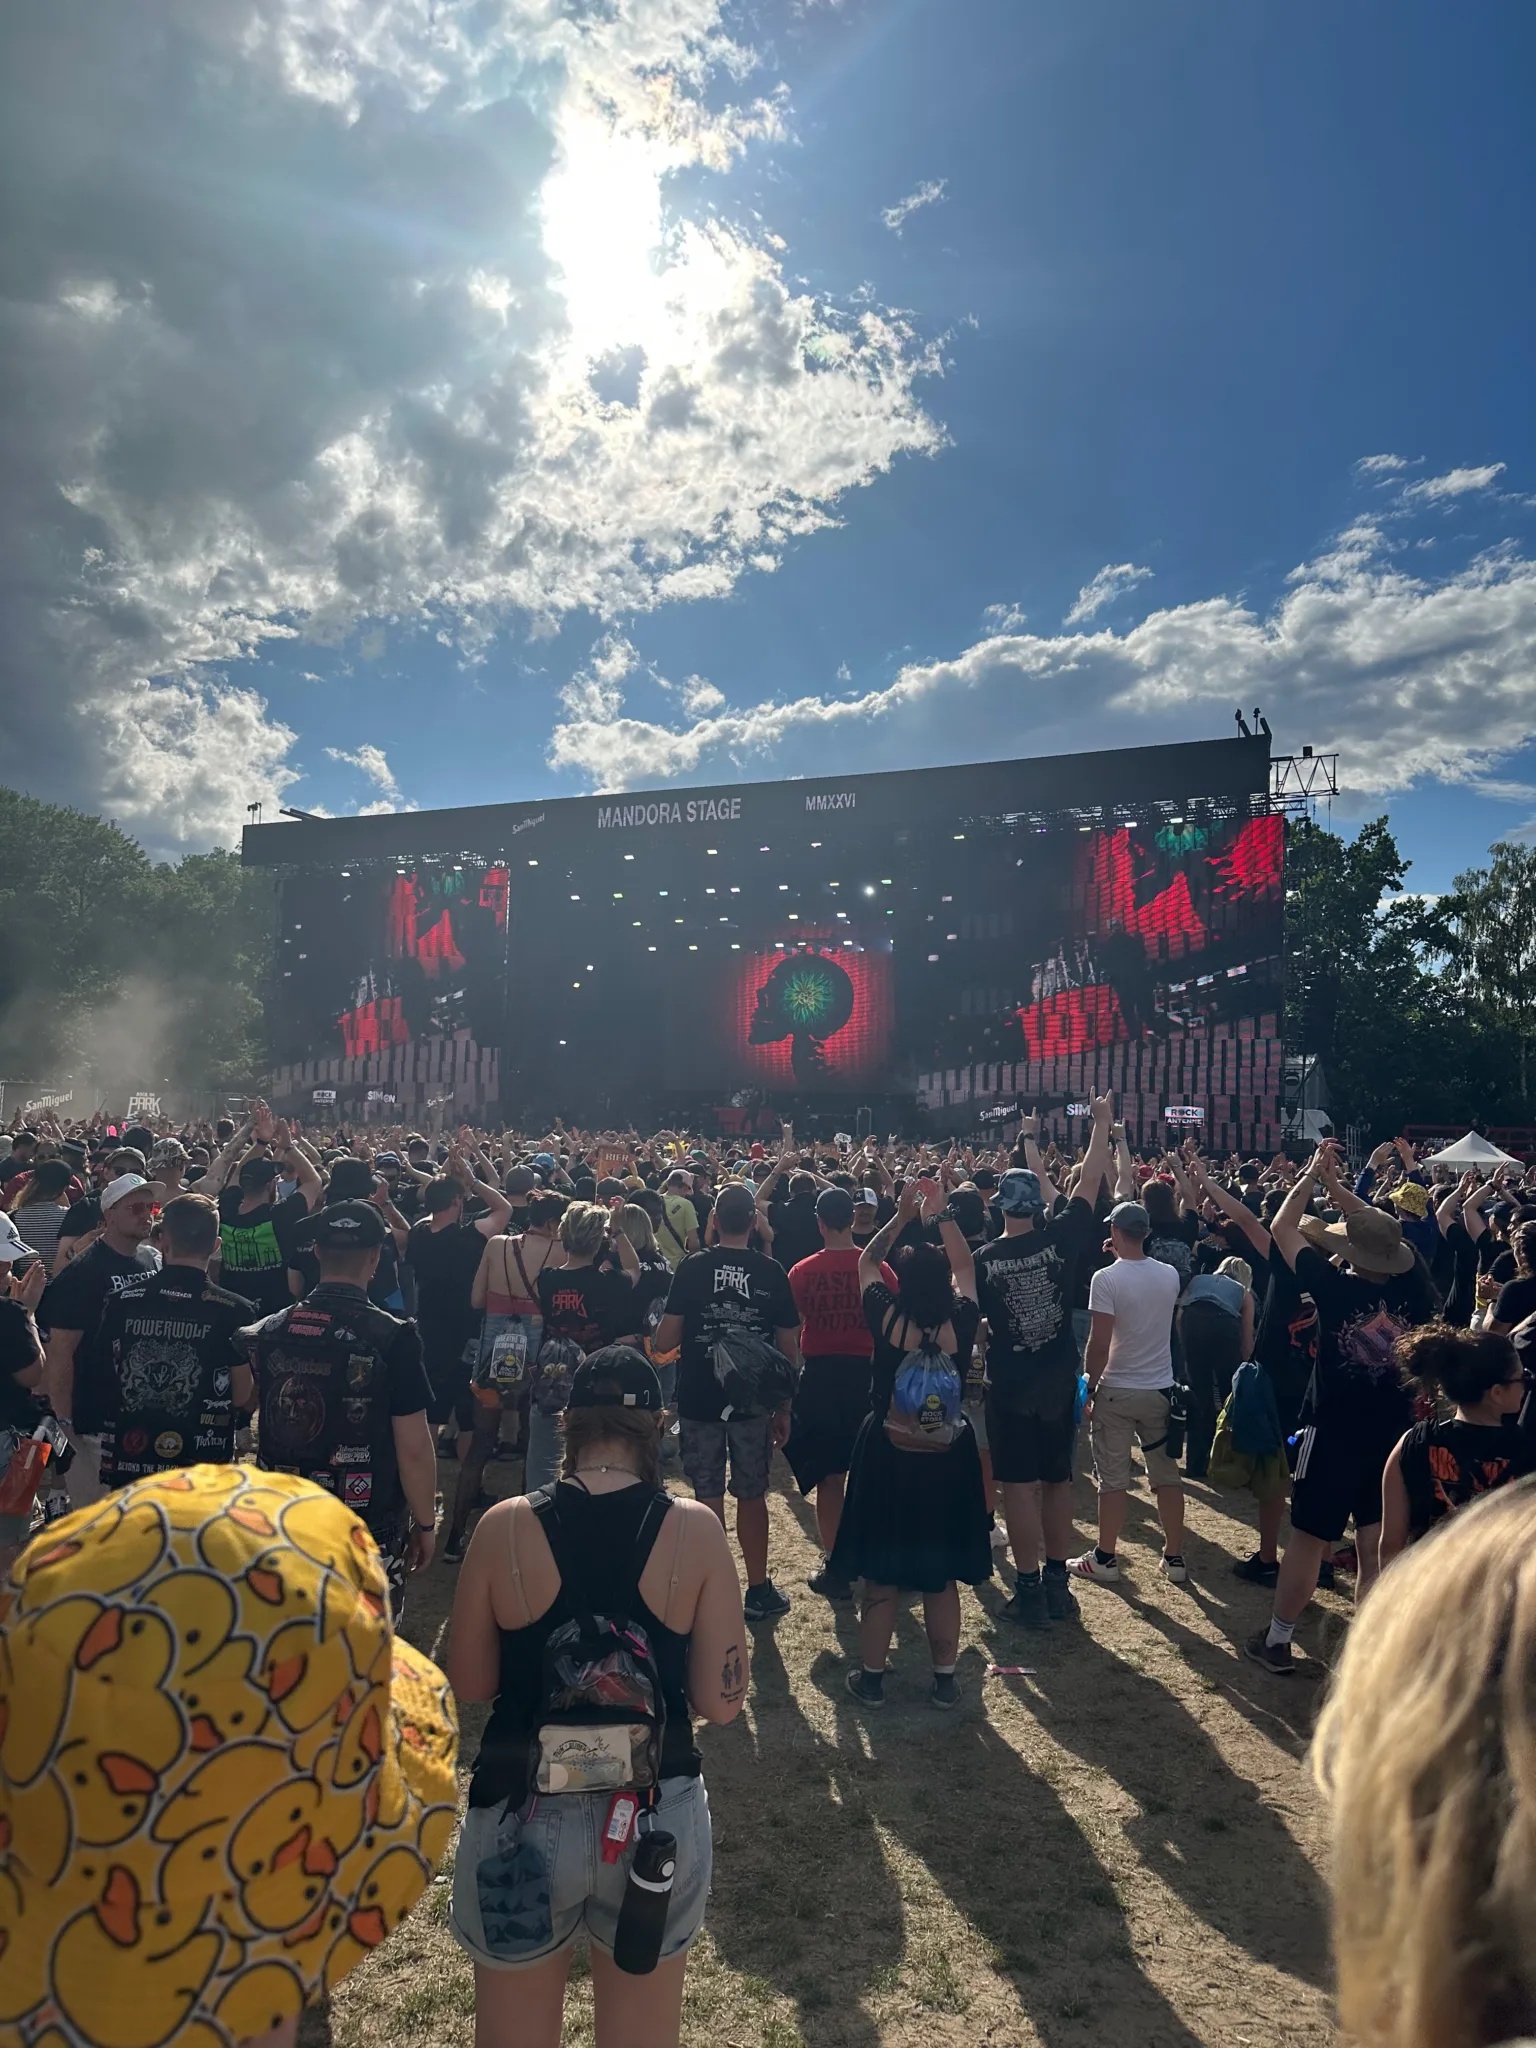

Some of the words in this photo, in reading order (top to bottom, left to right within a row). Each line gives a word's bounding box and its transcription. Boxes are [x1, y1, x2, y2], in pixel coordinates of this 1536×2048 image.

[805, 793, 856, 811] MMXXVI
[598, 802, 682, 828] MANDORA
[686, 798, 742, 822] STAGE
[127, 1096, 162, 1118] PARK
[1066, 1103, 1091, 1116] SIM
[1170, 1108, 1199, 1117] ROCK
[605, 1153, 629, 1161] BIER
[714, 1269, 751, 1299] PARK
[552, 1294, 588, 1318] PARK
[125, 1318, 212, 1340] POWERWOLF
[117, 1460, 141, 1472] BEYOND
[142, 1463, 155, 1473] THE
